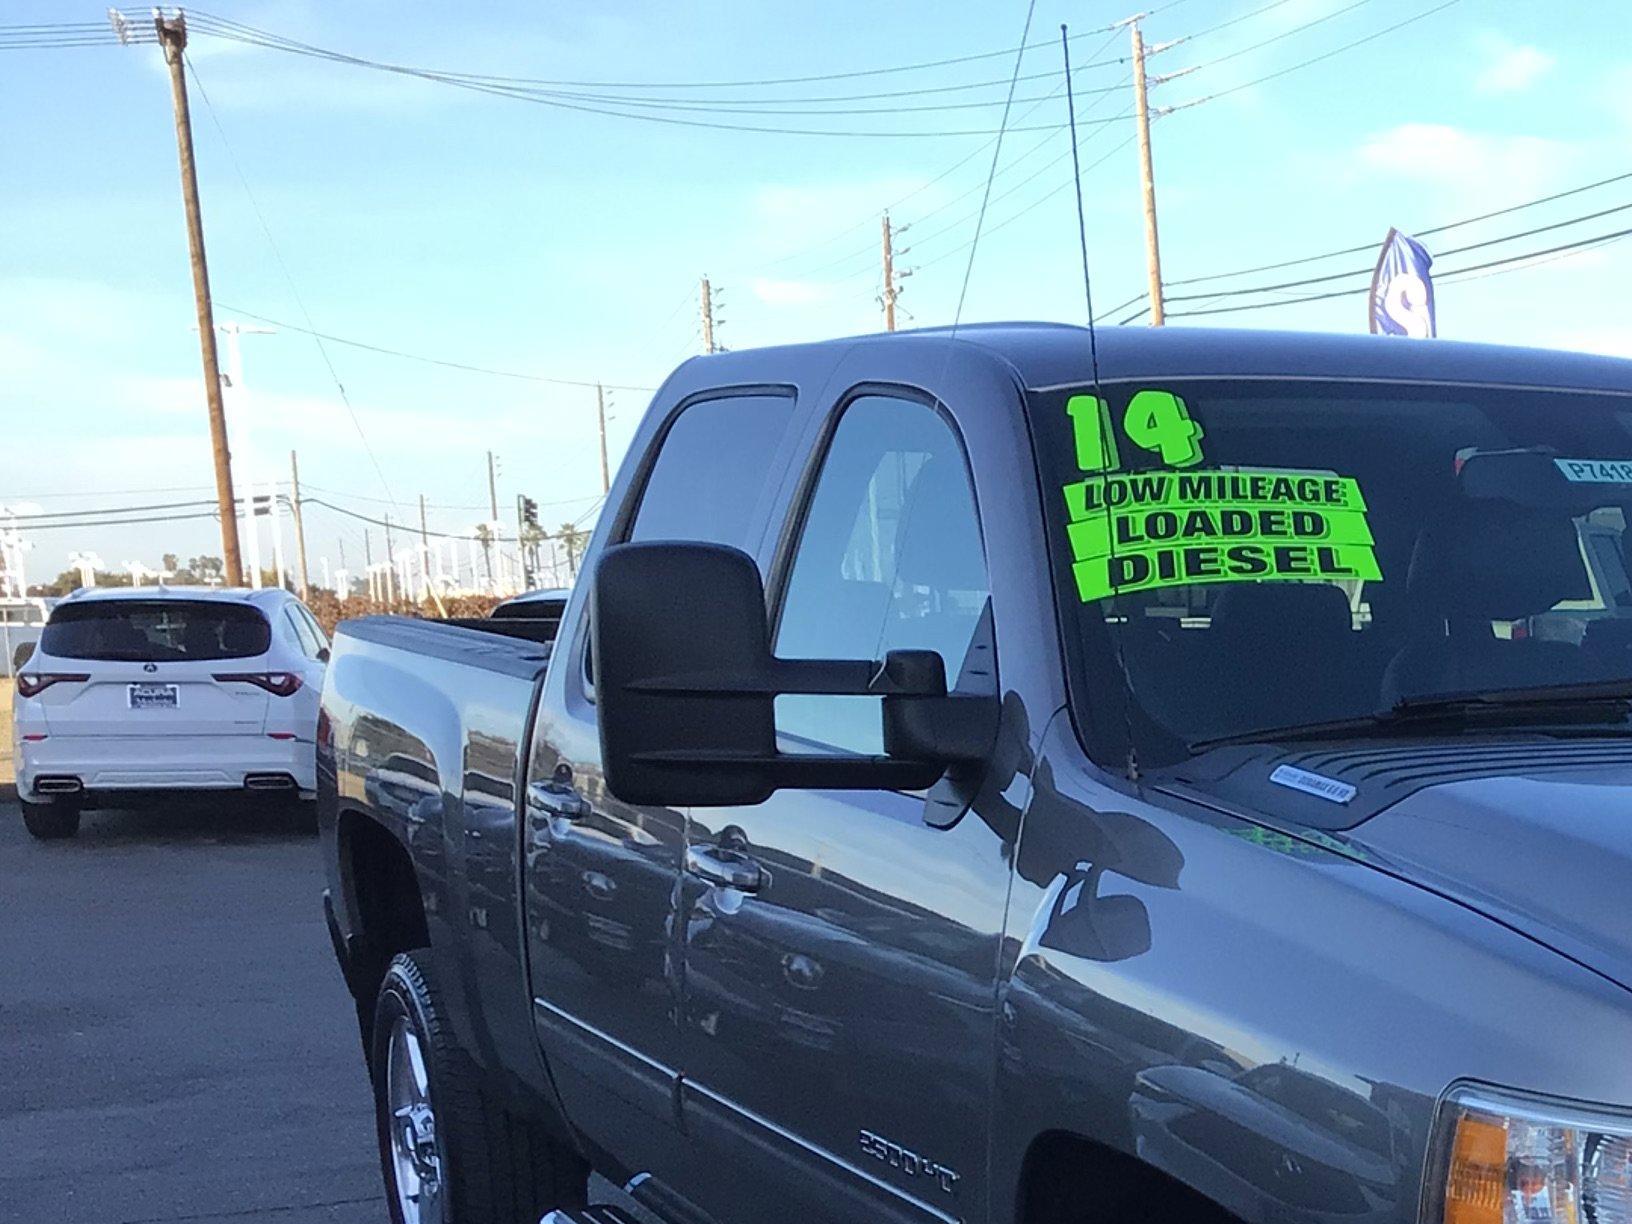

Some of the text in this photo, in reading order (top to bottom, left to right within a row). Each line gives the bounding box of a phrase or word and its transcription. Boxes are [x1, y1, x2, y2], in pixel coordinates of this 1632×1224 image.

[1066, 390, 1205, 471] 14
[1085, 475, 1346, 511] LOW MILEAGE
[1116, 509, 1330, 545] LOADED
[1107, 545, 1355, 589] DIESEL
